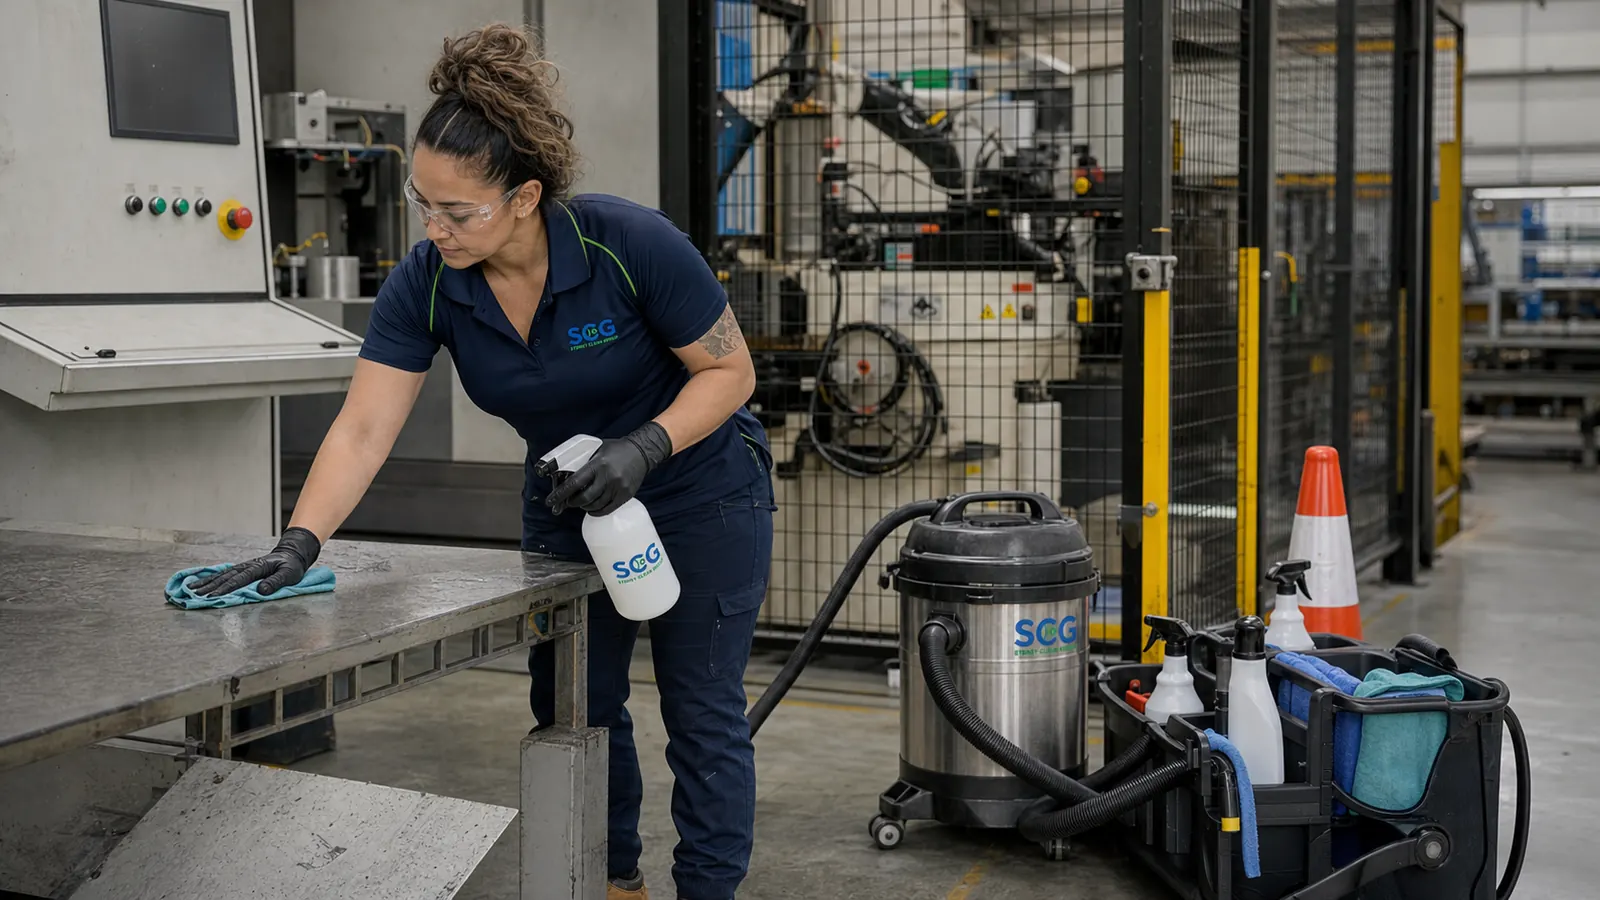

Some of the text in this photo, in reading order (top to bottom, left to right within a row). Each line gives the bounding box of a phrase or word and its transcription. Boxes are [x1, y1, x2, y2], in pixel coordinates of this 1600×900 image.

[568, 319, 616, 345] SCG
[612, 542, 661, 578] SCG
[1015, 616, 1077, 647] SCG
